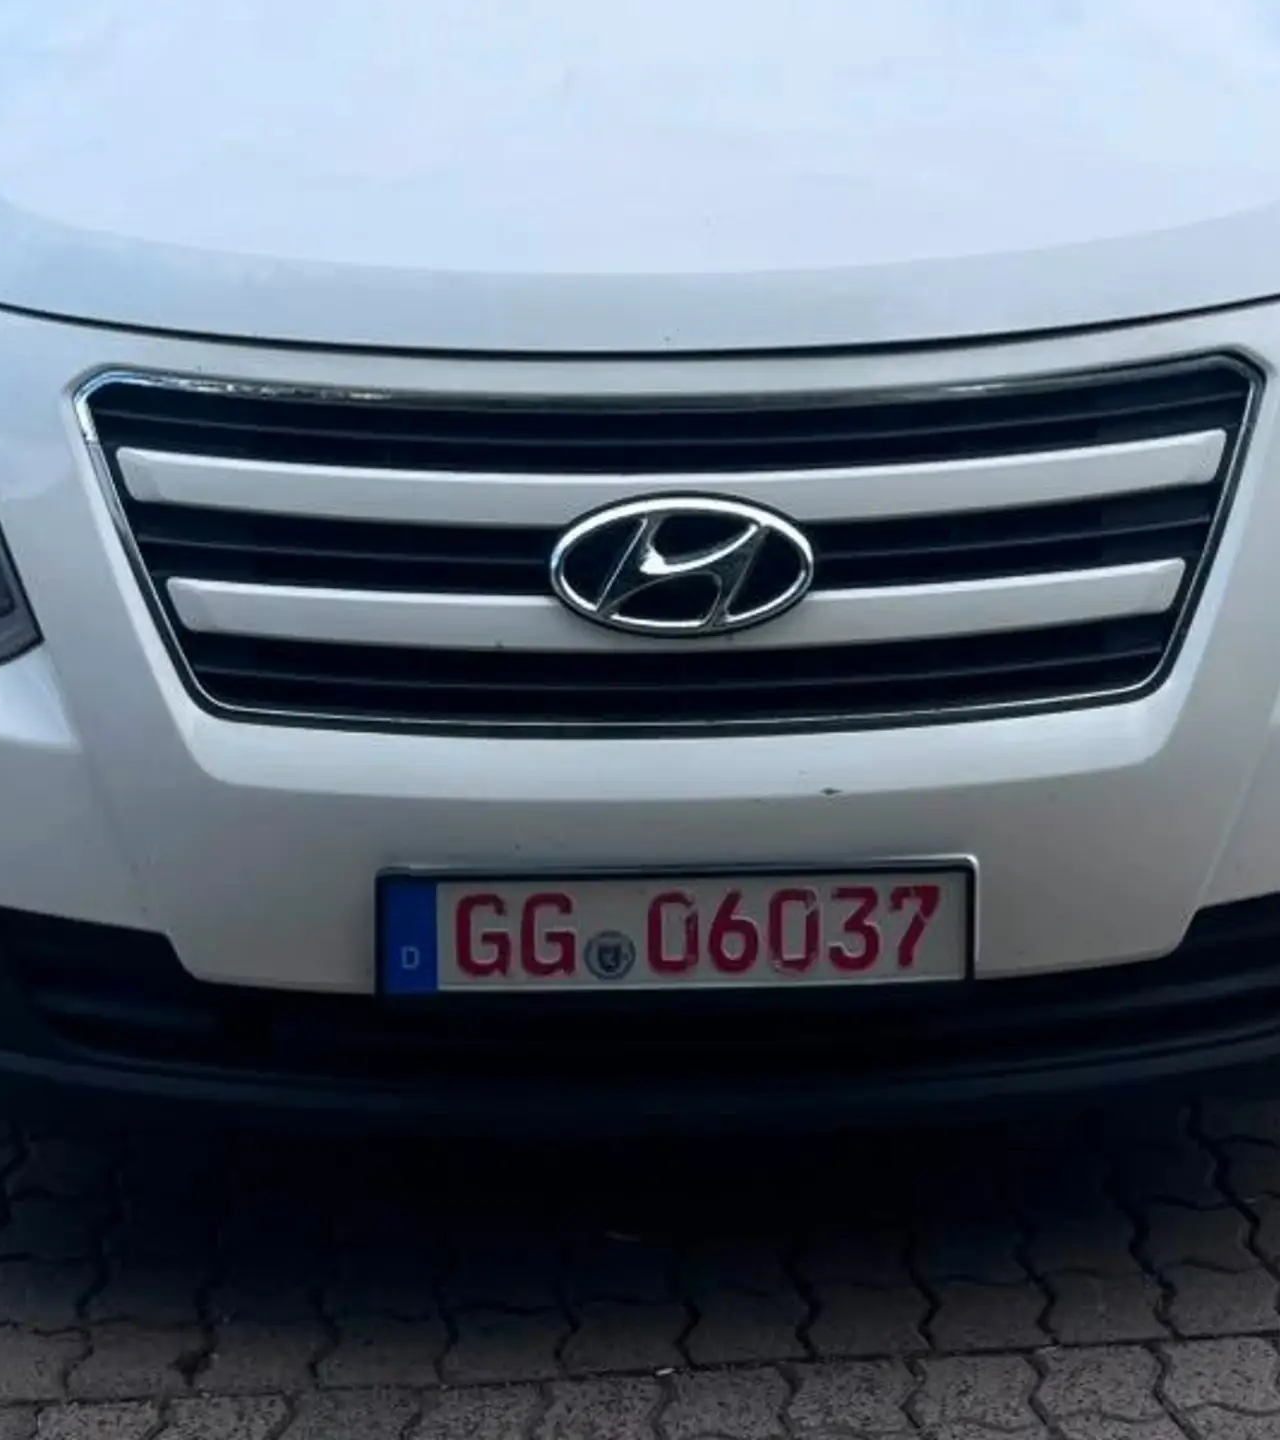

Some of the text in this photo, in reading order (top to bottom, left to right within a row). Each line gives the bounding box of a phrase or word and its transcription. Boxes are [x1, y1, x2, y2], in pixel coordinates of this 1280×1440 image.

[401, 946, 420, 970] D
[455, 884, 941, 978] GG 06037
